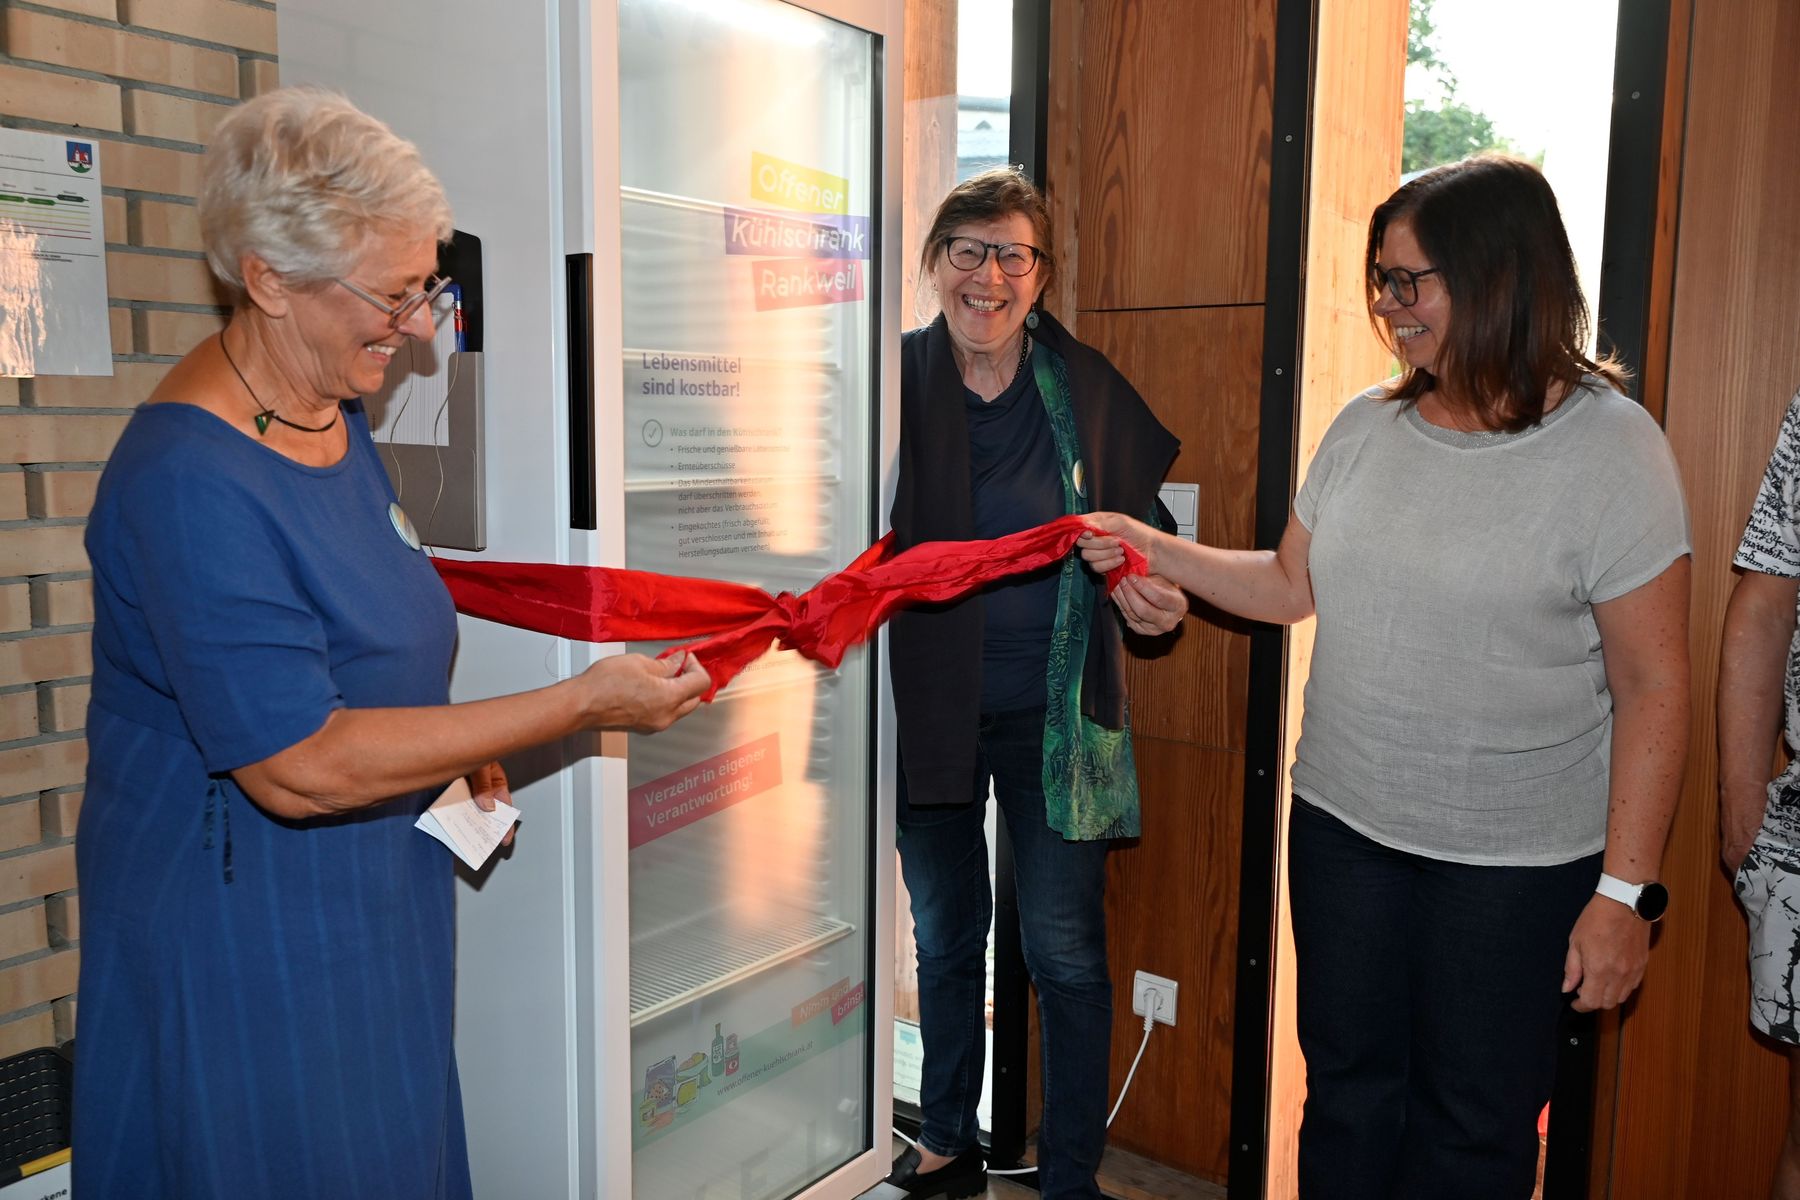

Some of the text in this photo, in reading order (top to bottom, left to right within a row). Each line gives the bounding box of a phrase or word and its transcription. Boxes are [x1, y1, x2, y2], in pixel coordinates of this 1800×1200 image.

[759, 164, 843, 210] Offener
[731, 216, 865, 251] Kühlschrank
[761, 265, 856, 297] Rankweil
[642, 353, 742, 374] Lebensmittel
[642, 378, 740, 398] sind kostbar!
[671, 427, 687, 437] Was
[689, 427, 706, 437] darf
[708, 427, 715, 437] in
[717, 427, 731, 437] den
[678, 445, 701, 454] Frische
[703, 446, 715, 454] und
[679, 492, 692, 501] darf
[679, 506, 695, 515] nicht
[696, 505, 711, 514] aber
[713, 504, 723, 513] das
[679, 537, 690, 547] gut
[691, 534, 732, 544] verschlossen
[734, 532, 745, 540] und
[679, 547, 740, 558] Herstellungsdatum
[644, 748, 767, 806] Verzehr in eigener
[647, 773, 753, 828] Verantwortung!
